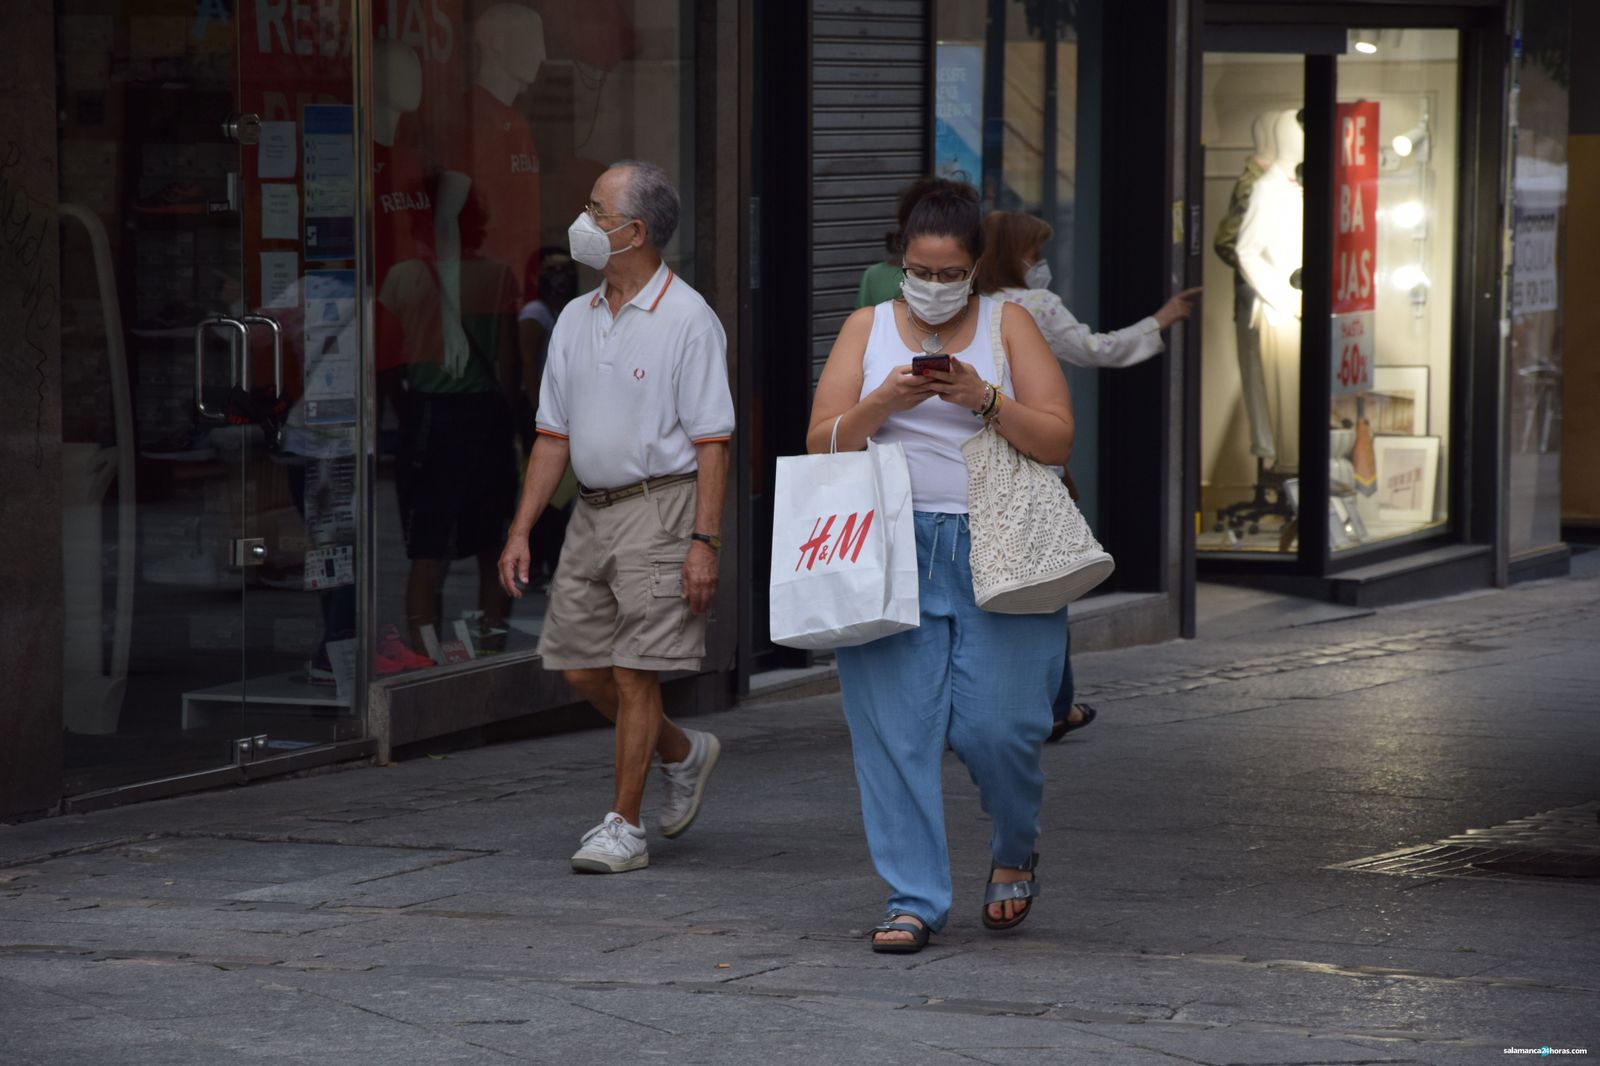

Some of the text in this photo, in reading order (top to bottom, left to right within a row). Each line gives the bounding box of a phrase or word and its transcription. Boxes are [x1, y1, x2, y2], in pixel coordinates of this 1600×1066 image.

[254, 0, 454, 64] REBJAS
[1341, 115, 1366, 167] RE
[1339, 184, 1365, 234] BA
[1337, 248, 1371, 303] JAS
[1341, 320, 1366, 337] HASTA
[795, 509, 874, 572] H&M
